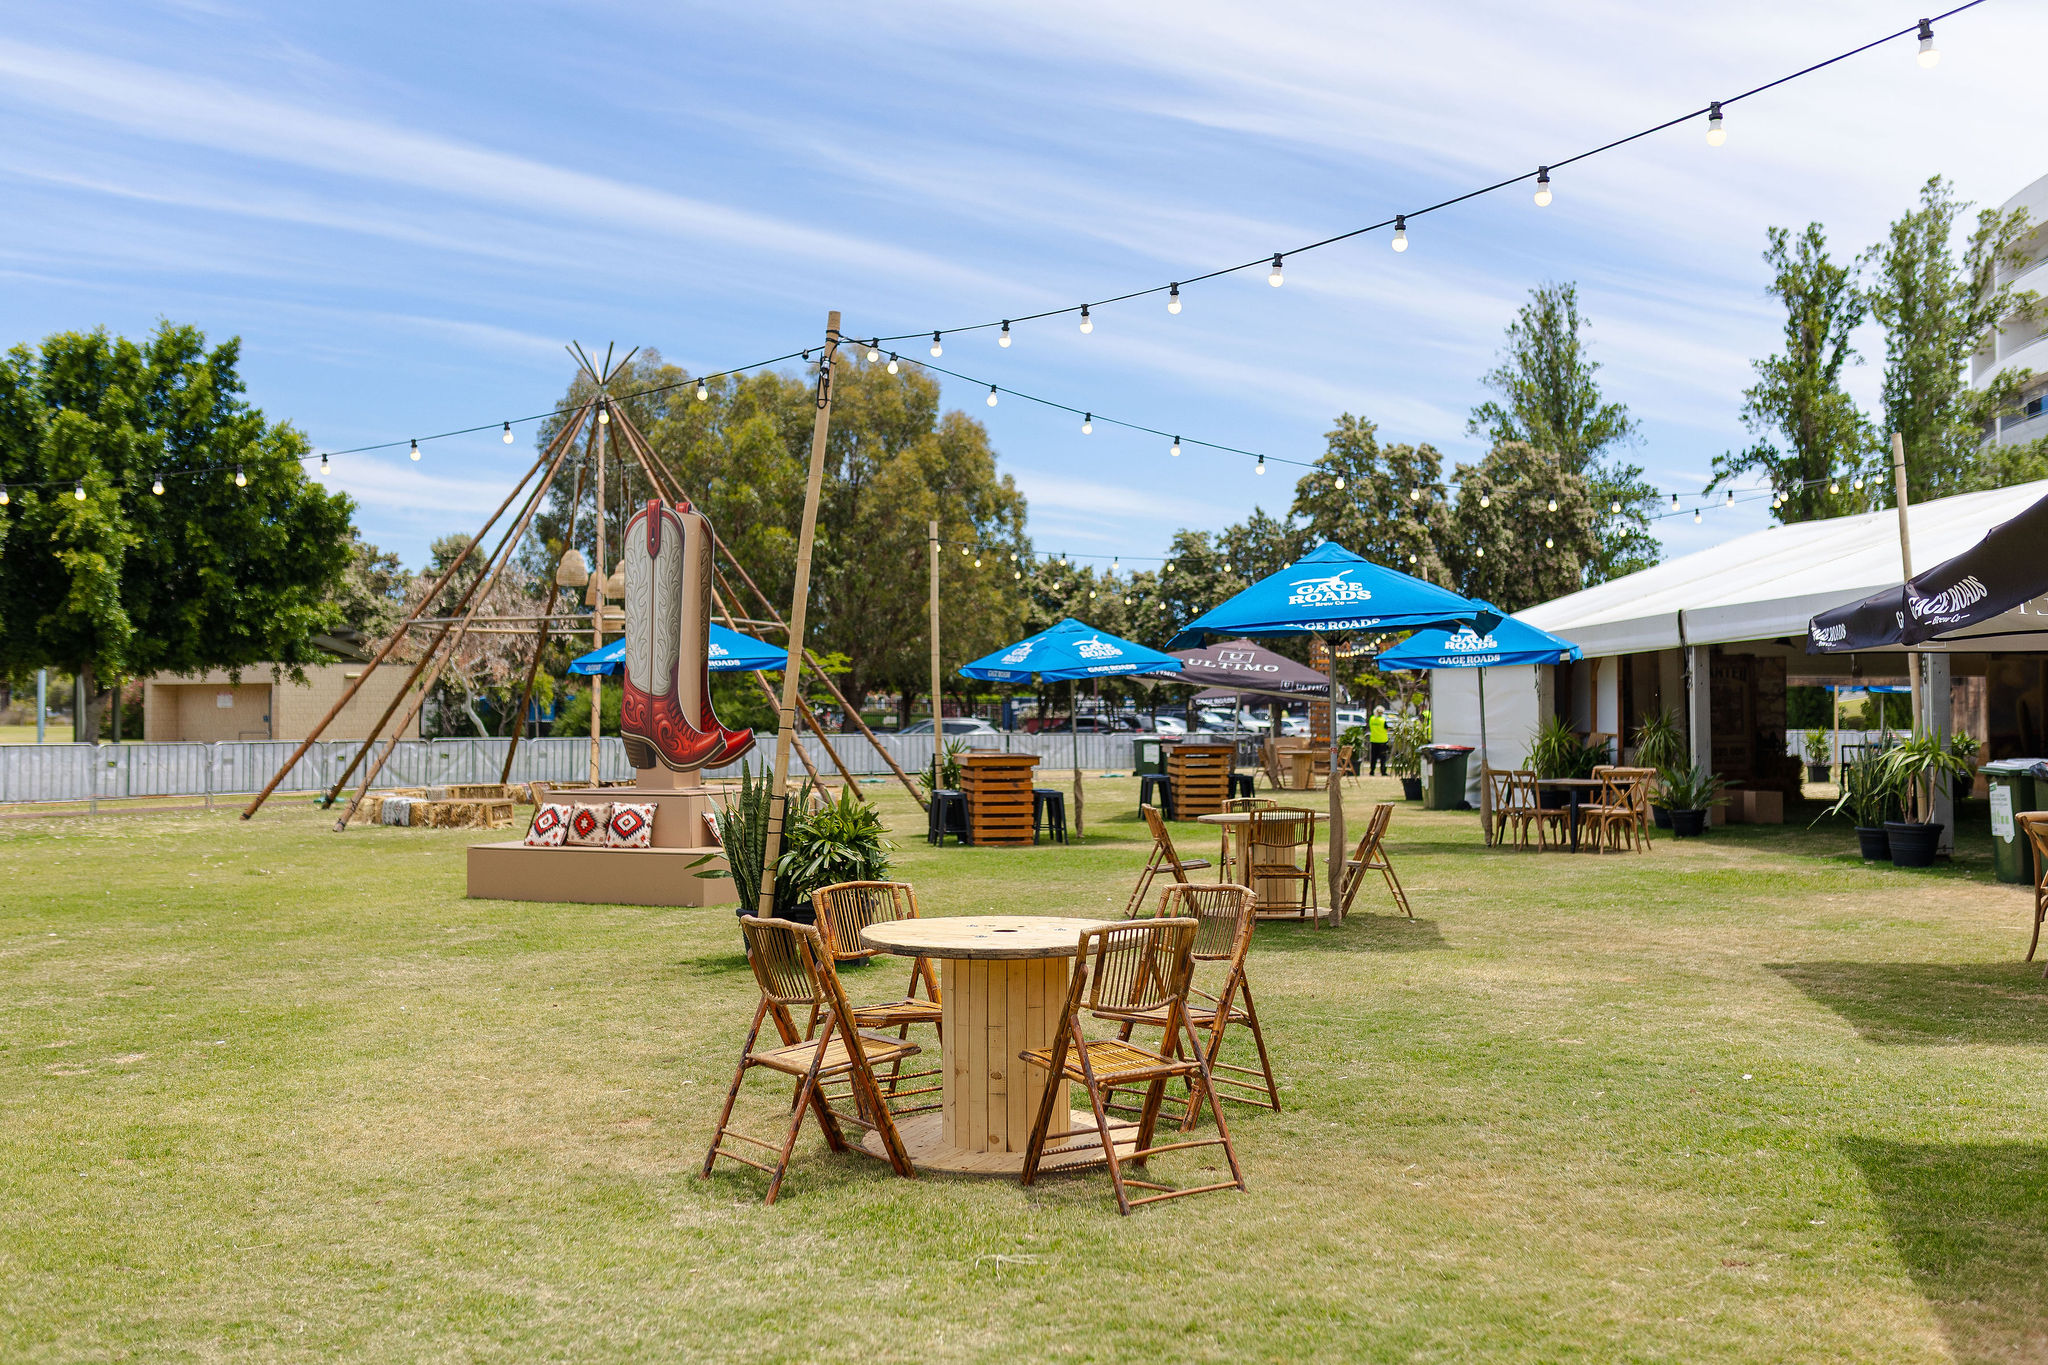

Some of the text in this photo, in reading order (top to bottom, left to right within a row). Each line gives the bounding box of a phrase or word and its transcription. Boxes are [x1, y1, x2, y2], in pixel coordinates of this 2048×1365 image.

[1296, 581, 1363, 595] GAGE
[1288, 590, 1372, 605] ROADS
[1444, 640, 1498, 650] ROADS
[1188, 658, 1279, 673] ULTIMO
[1438, 654, 1500, 665] GAGE ROADS
